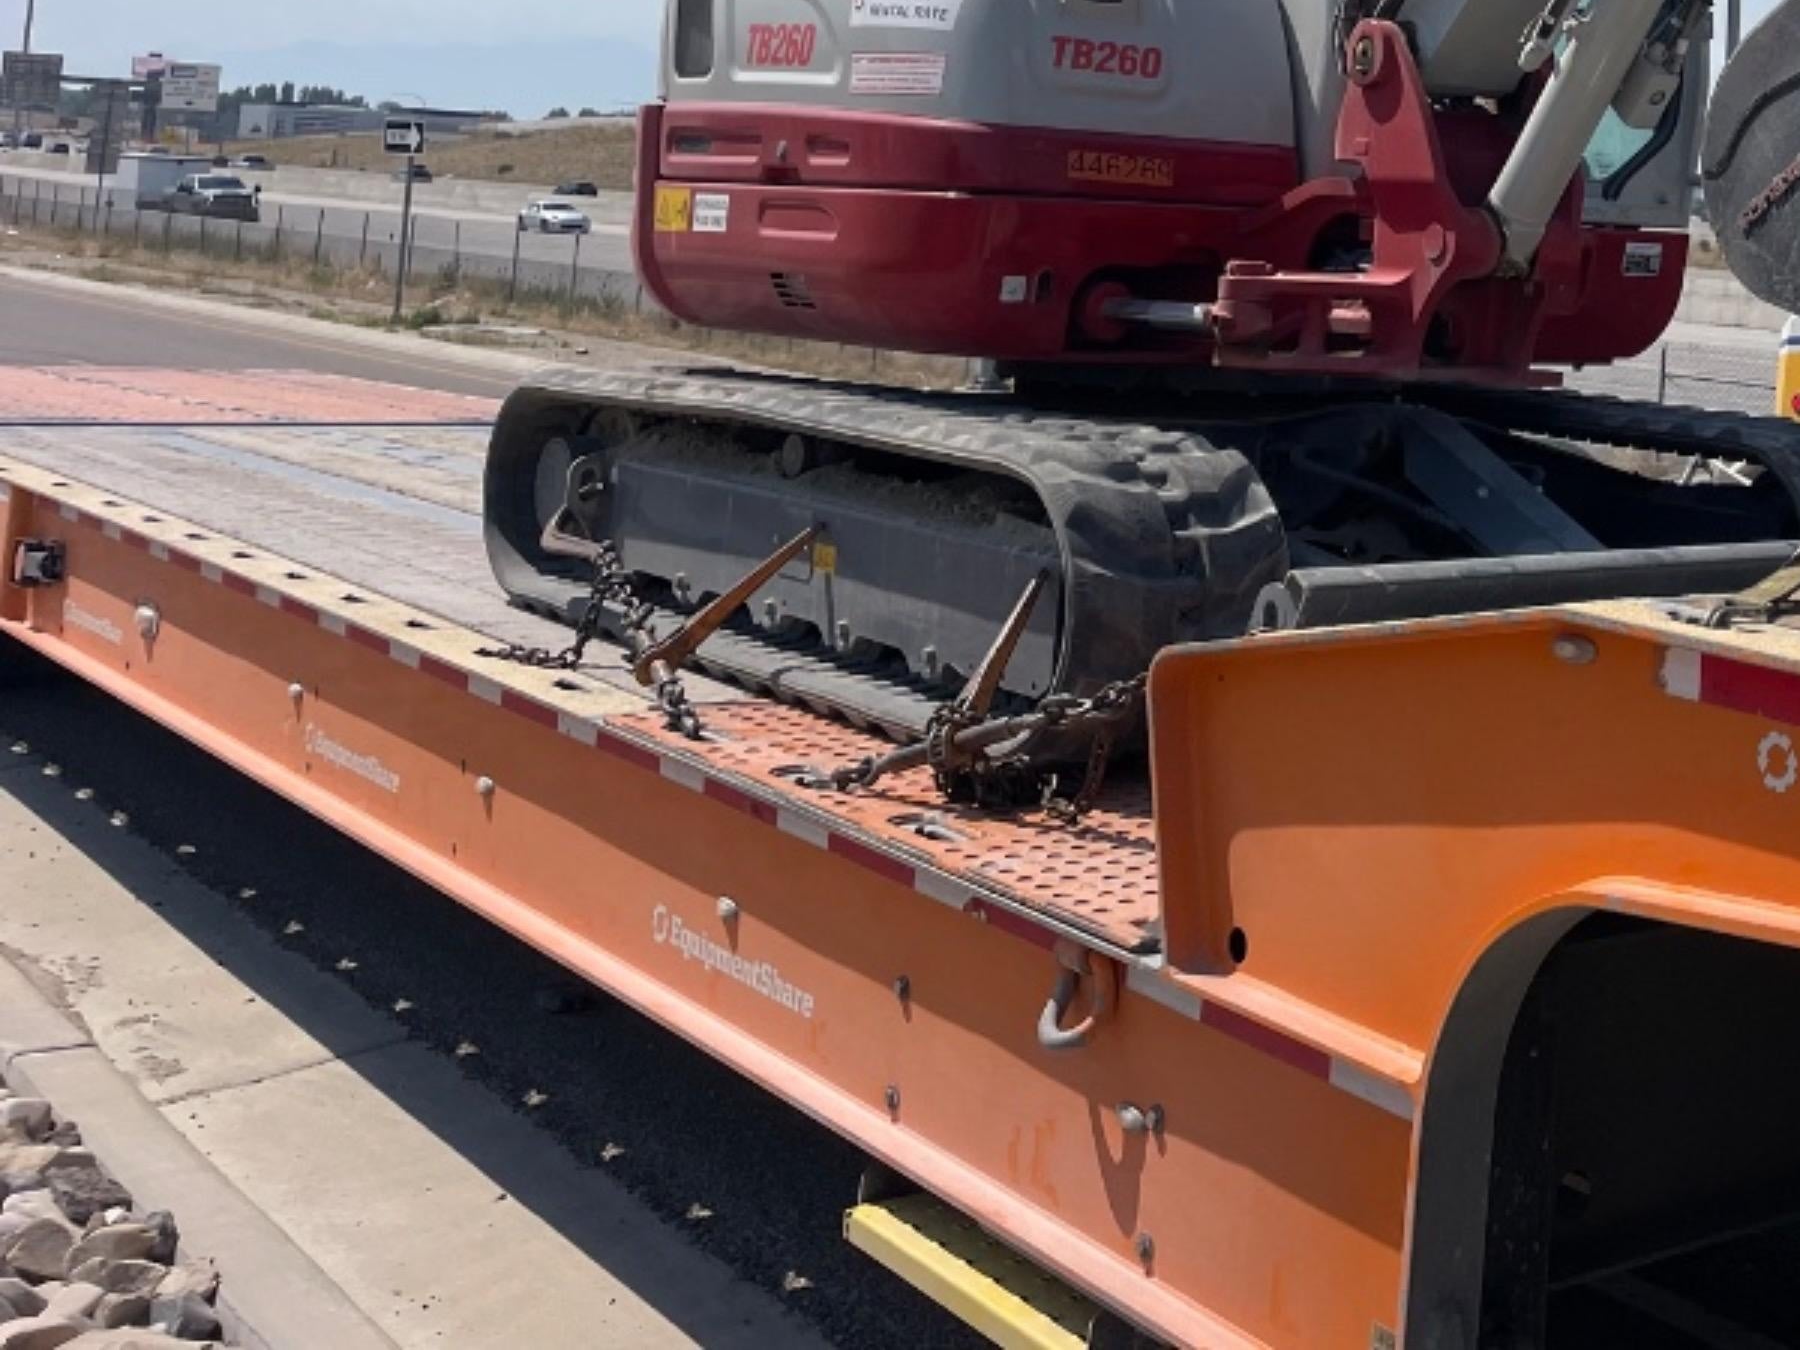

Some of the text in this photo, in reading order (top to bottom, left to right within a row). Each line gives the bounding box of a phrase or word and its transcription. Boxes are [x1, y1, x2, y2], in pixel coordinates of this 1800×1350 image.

[746, 23, 816, 67] TB260
[1051, 35, 1162, 79] TB260
[669, 915, 815, 1019] EquipmentShare
